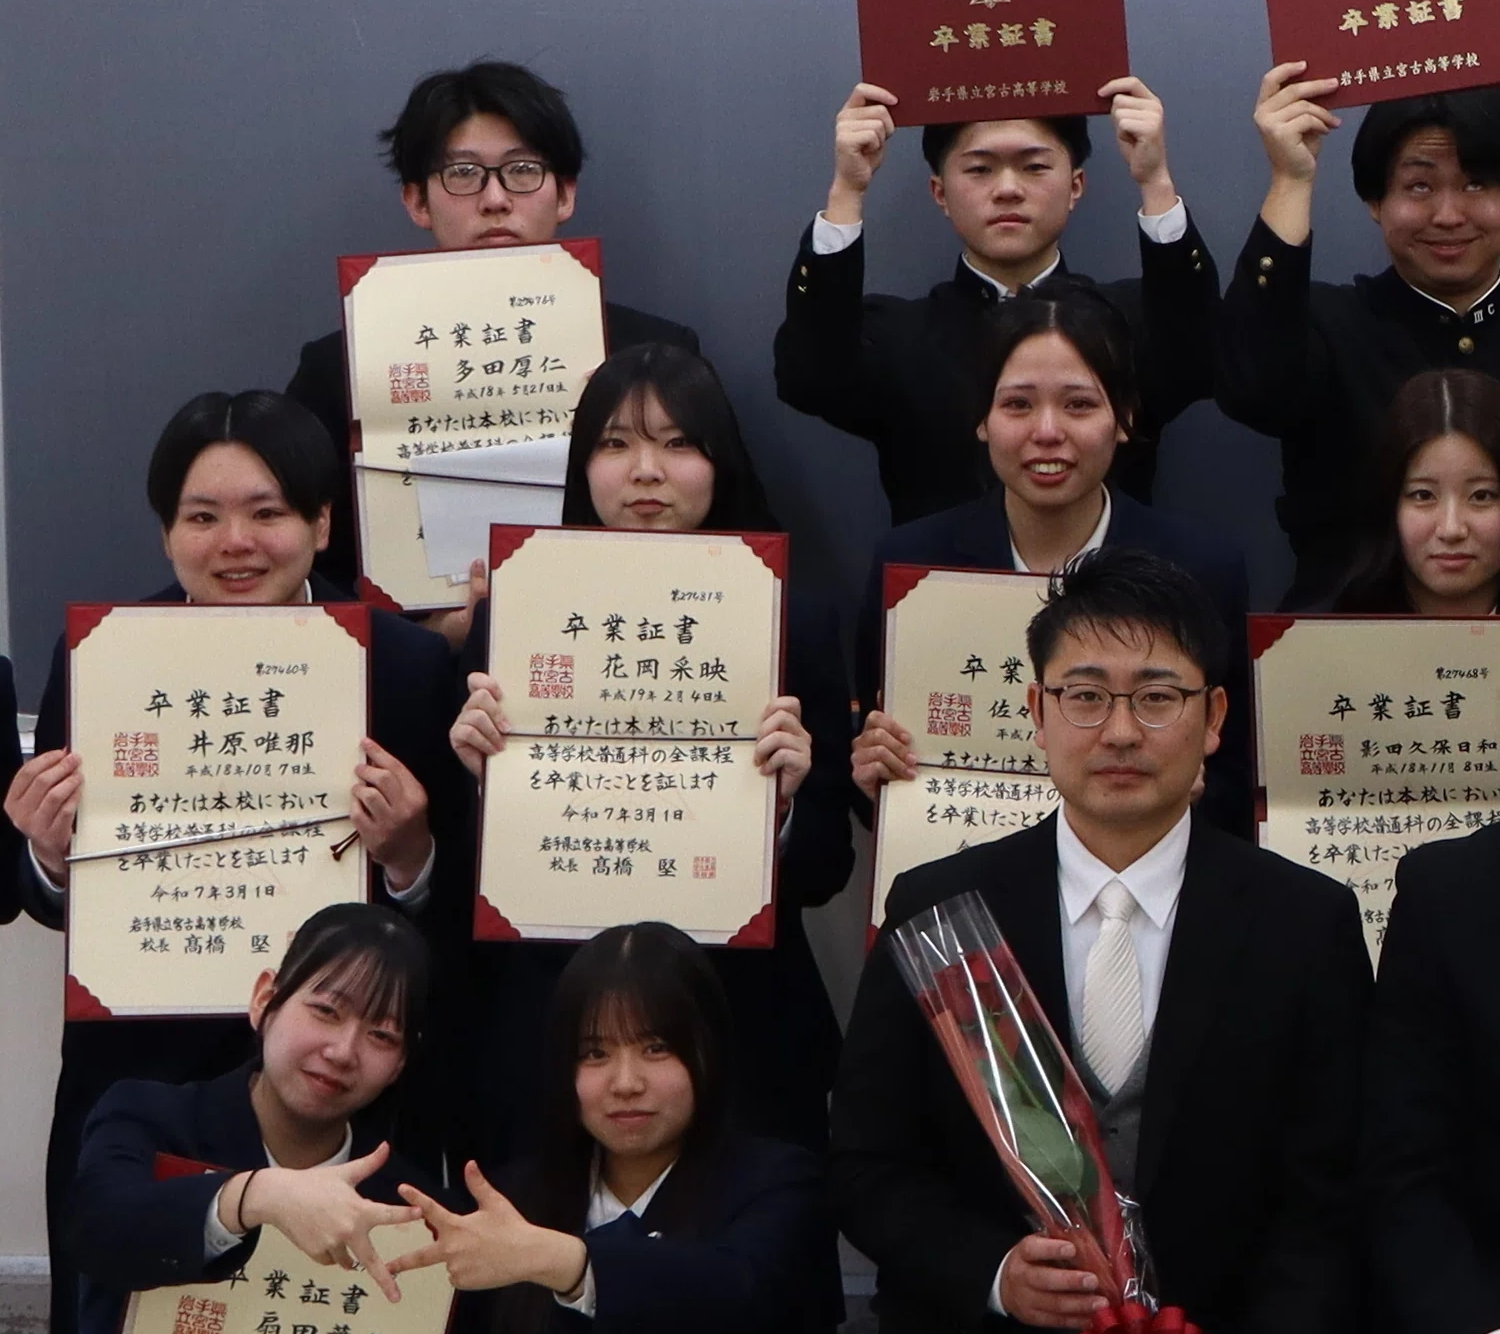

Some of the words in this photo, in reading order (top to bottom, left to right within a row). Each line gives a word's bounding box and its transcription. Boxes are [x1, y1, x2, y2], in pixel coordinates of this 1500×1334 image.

[929, 17, 1057, 53] 卒業証書
[1488, 303, 1495, 315] C
[415, 318, 536, 349] 卒業証書
[561, 613, 699, 644] 卒業証書
[601, 654, 730, 682] 花岡采映
[144, 688, 285, 718] 卒業証書
[1329, 691, 1466, 720] 卒業証書
[544, 716, 740, 736] あなたは本校において
[530, 772, 719, 792] を卒業したことを証します
[562, 806, 683, 823] 令和7年3月1日
